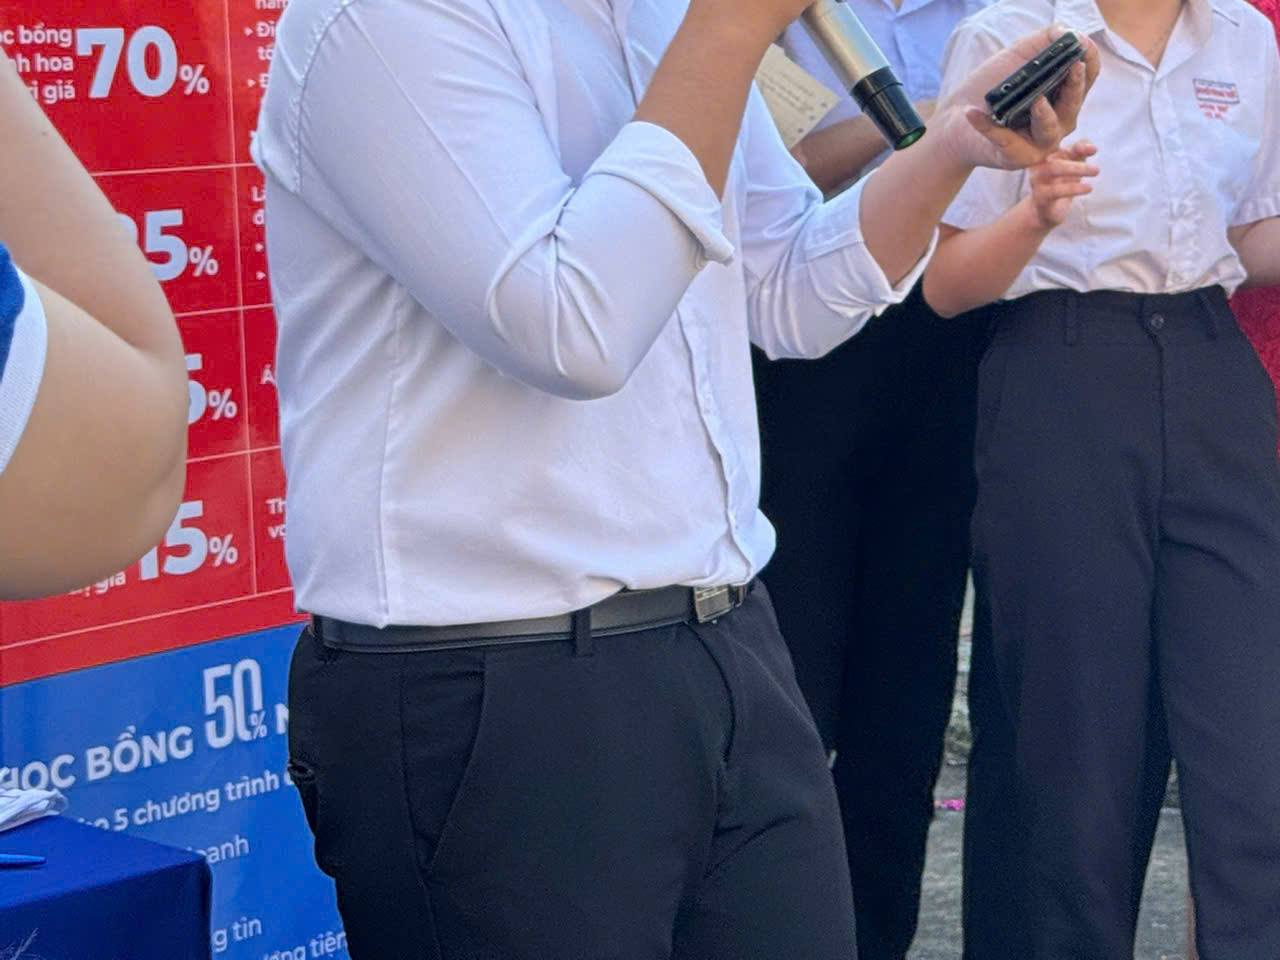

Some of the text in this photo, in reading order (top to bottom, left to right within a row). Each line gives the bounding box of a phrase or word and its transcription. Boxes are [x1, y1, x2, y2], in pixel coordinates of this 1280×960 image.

[18, 22, 73, 48] bổng
[34, 53, 74, 72] hoa
[42, 79, 76, 105] giá
[117, 208, 219, 282] 5%
[86, 725, 194, 782] BỔNG
[113, 807, 129, 831] 5
[133, 789, 221, 826] chương
[226, 769, 280, 801] trình
[232, 916, 262, 941] tin
